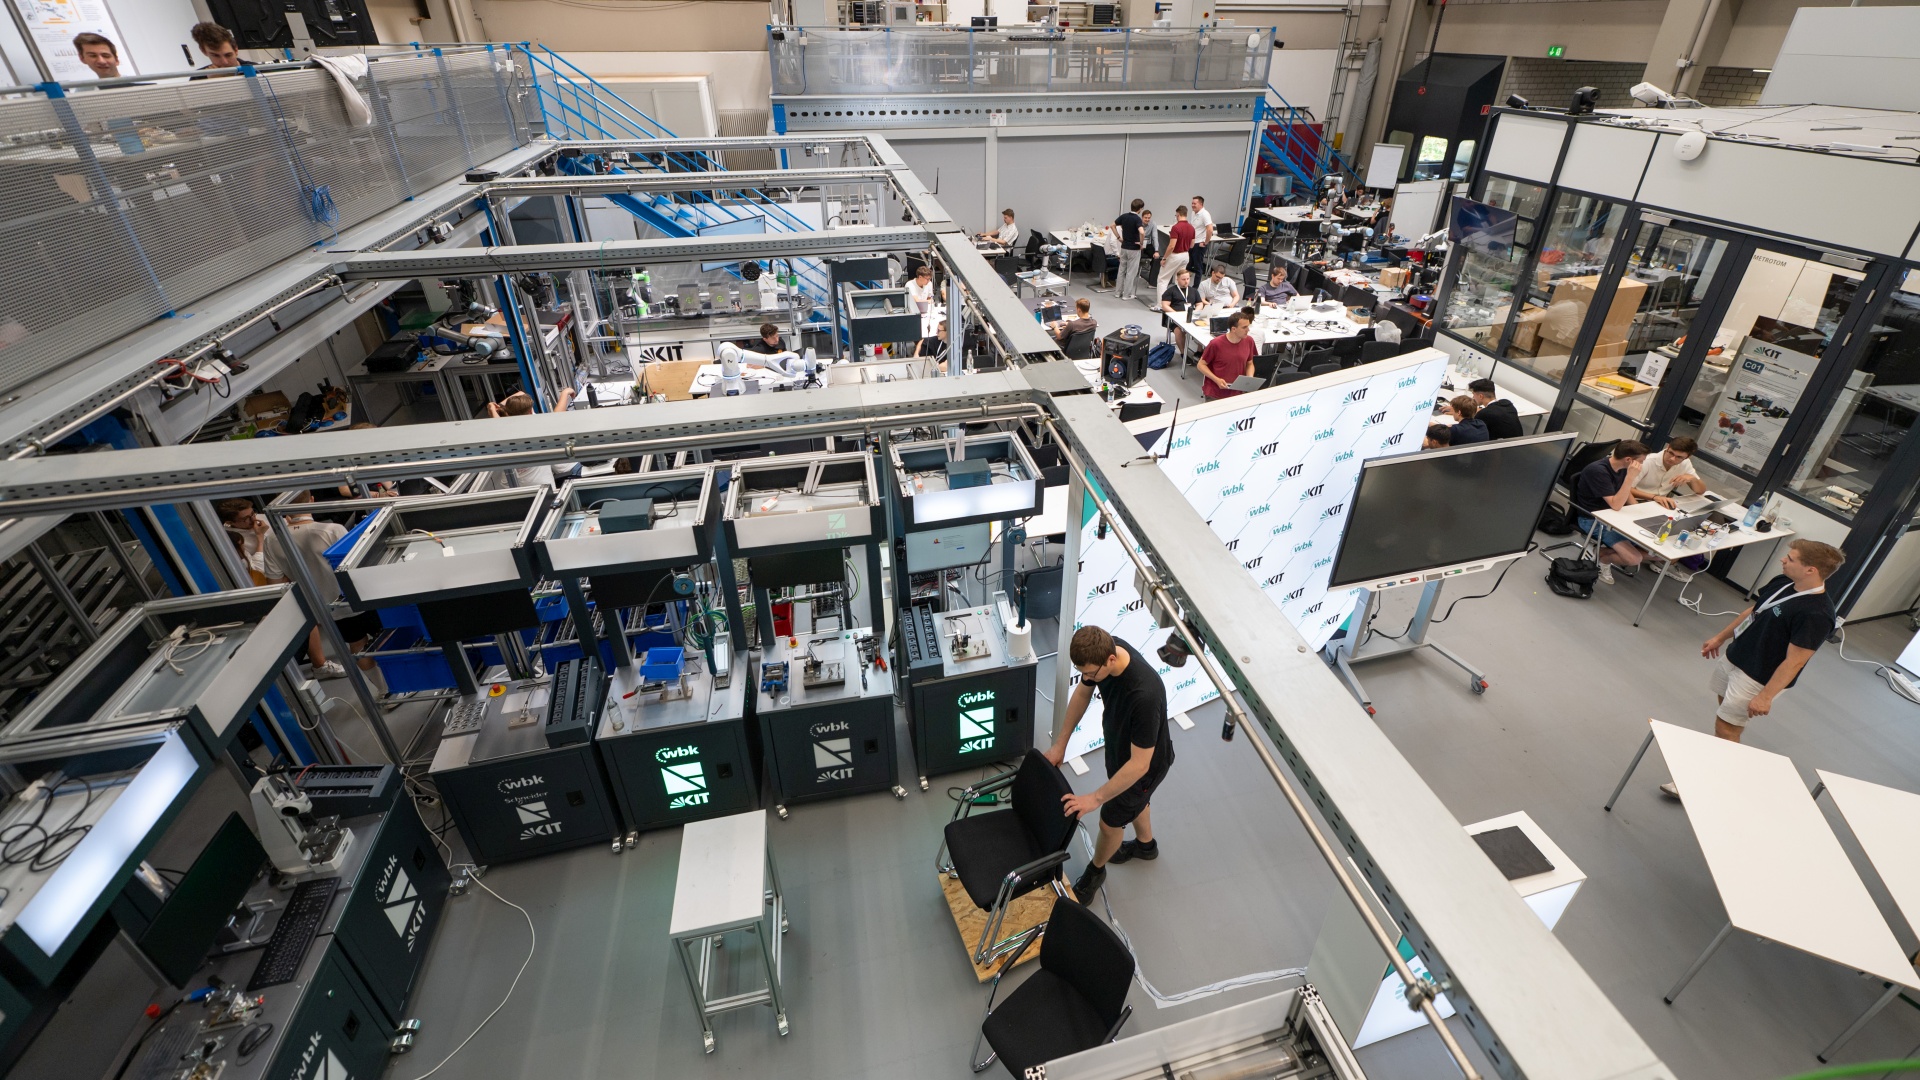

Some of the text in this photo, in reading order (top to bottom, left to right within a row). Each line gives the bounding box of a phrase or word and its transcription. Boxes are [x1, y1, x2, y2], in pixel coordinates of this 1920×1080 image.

[1752, 254, 1787, 267] METROTOM
[649, 345, 683, 362] KIT
[1762, 346, 1782, 359] KIT
[1744, 361, 1762, 372] C01
[1398, 375, 1417, 389] wbk
[1350, 387, 1368, 402] KIT
[1290, 404, 1312, 418] wbk
[1415, 399, 1433, 412] wbk
[1235, 417, 1256, 432] KIT
[1370, 411, 1387, 424] KIT
[1315, 428, 1335, 441] wbk
[1388, 433, 1404, 446] KIT
[1259, 441, 1279, 456] KIT
[1335, 449, 1355, 463] wbk
[1196, 460, 1220, 475] wbk
[1285, 463, 1304, 477] KIT
[1222, 482, 1245, 497] wbk
[1307, 484, 1325, 497] KIT
[1249, 503, 1271, 517] wbk
[1327, 503, 1344, 516] KIT
[1272, 522, 1293, 535] wbk
[1294, 540, 1313, 553] wbk
[1245, 556, 1263, 569] KIT
[1314, 556, 1332, 569] wbk
[1268, 573, 1285, 585] KIT
[1096, 579, 1118, 594] KIT
[1289, 587, 1305, 600] KIT
[1125, 599, 1144, 612] KIT
[1308, 602, 1323, 614] KIT
[1326, 613, 1341, 626] KIT
[1069, 674, 1081, 687] IT
[1176, 677, 1197, 691] wbk
[962, 690, 995, 704] wbk
[815, 720, 850, 734] wbk
[965, 736, 995, 751] KIT
[1088, 737, 1105, 749] wb
[662, 745, 700, 759] wbk
[825, 767, 855, 781] KIT
[504, 775, 545, 789] wbk
[504, 792, 549, 804] Schneider
[679, 792, 710, 806] KIT
[529, 821, 562, 836] KIT
[378, 854, 398, 893] wbk
[409, 900, 426, 937] KIT
[295, 1031, 322, 1080] wbk
